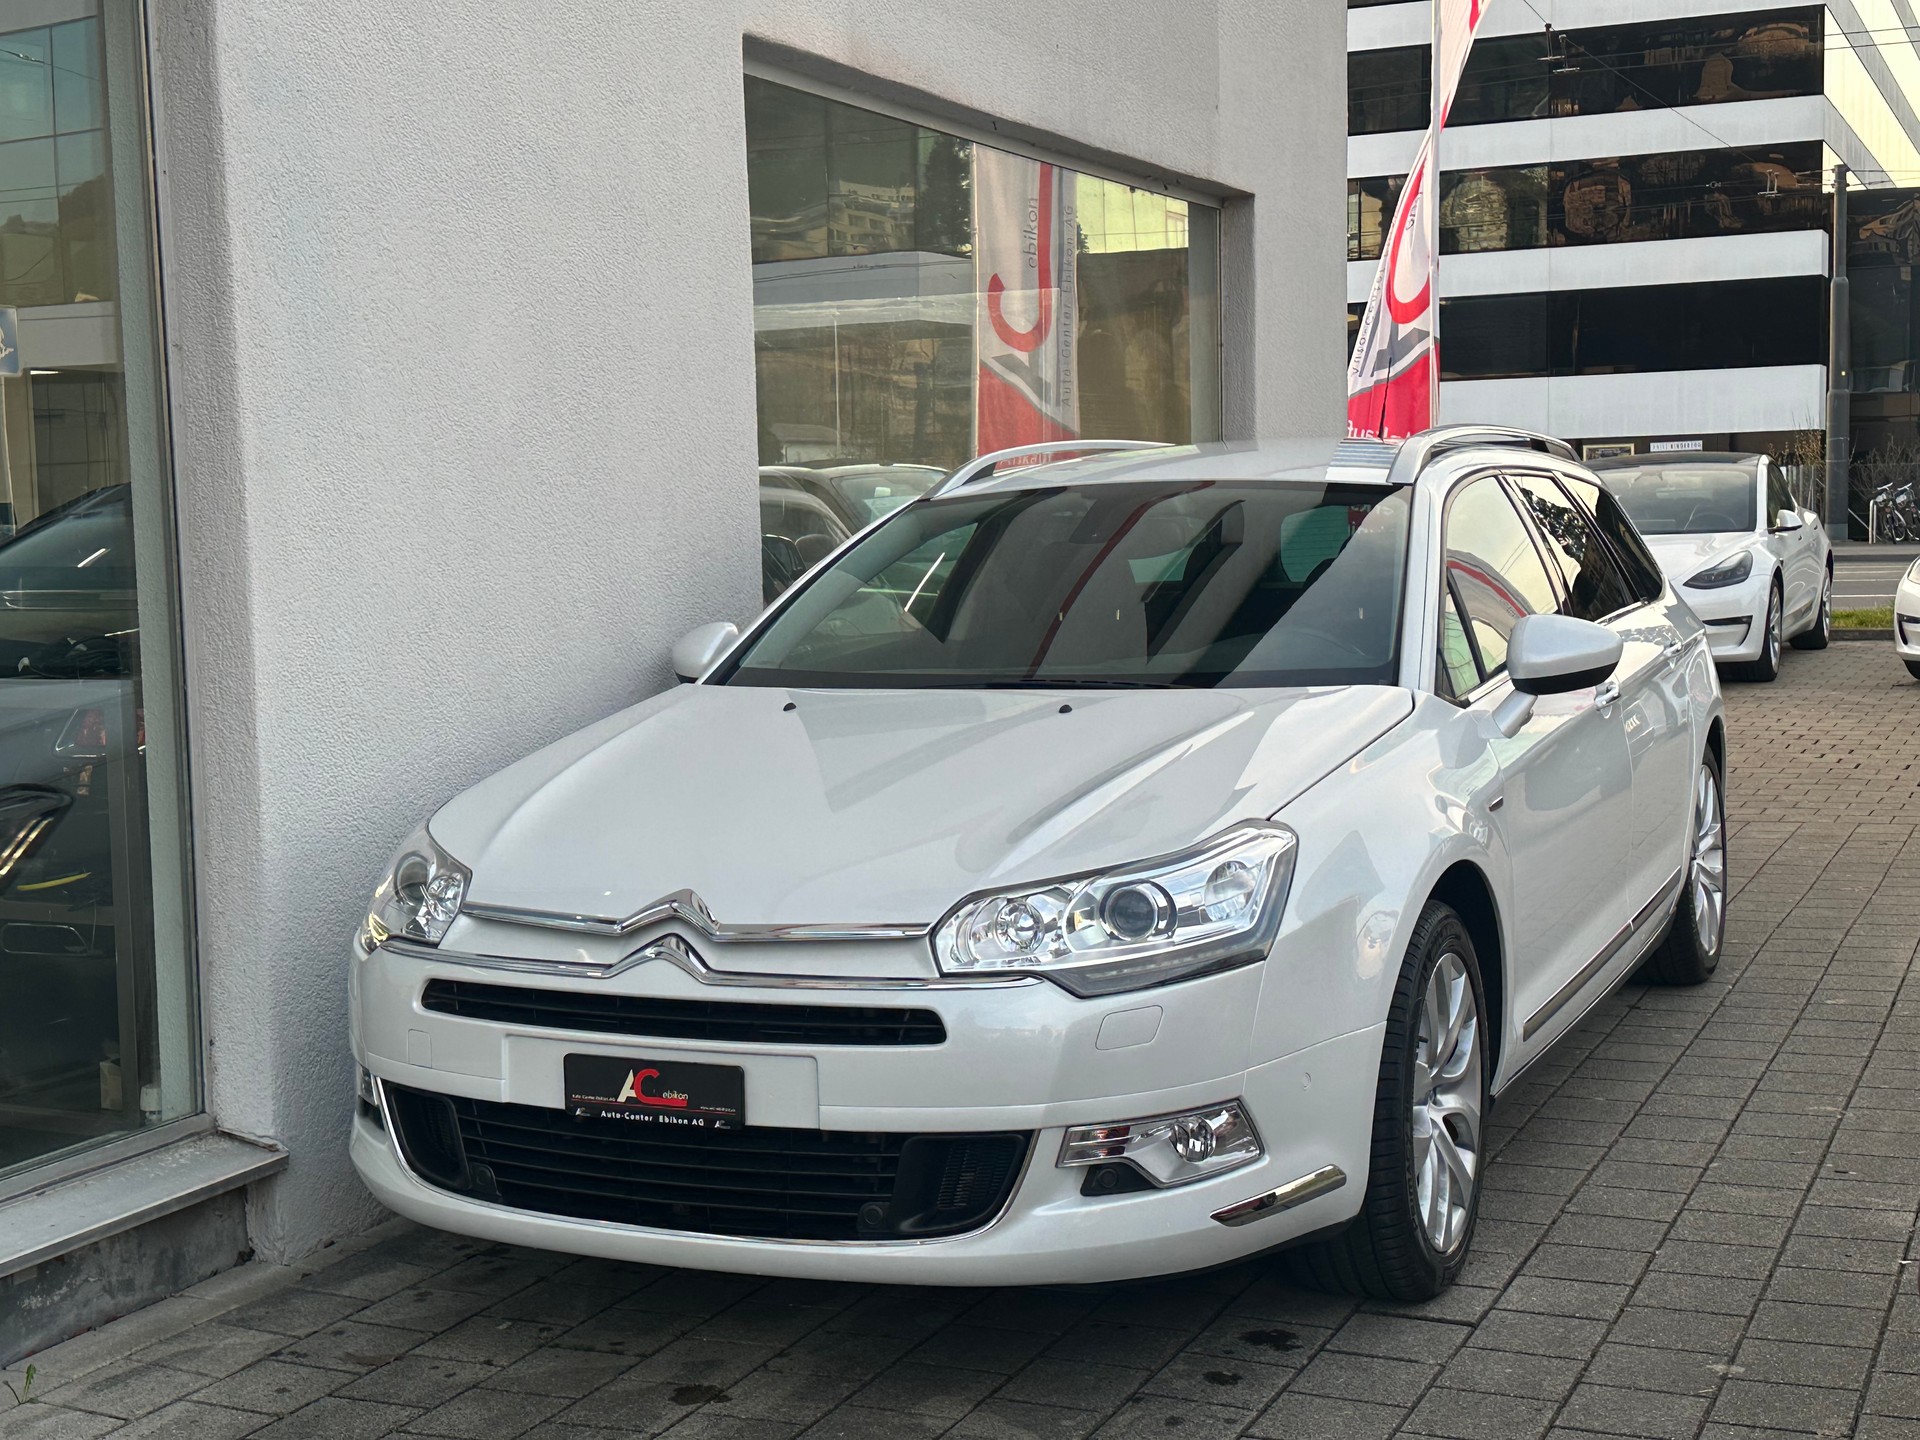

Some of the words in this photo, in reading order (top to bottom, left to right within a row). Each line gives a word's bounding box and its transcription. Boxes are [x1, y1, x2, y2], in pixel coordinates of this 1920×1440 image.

[1023, 198, 1039, 269] ebikon
[617, 1068, 687, 1106] AC
[660, 1090, 689, 1100] ebikon
[658, 1115, 688, 1125] Ebikon
[692, 1118, 704, 1127] AG
